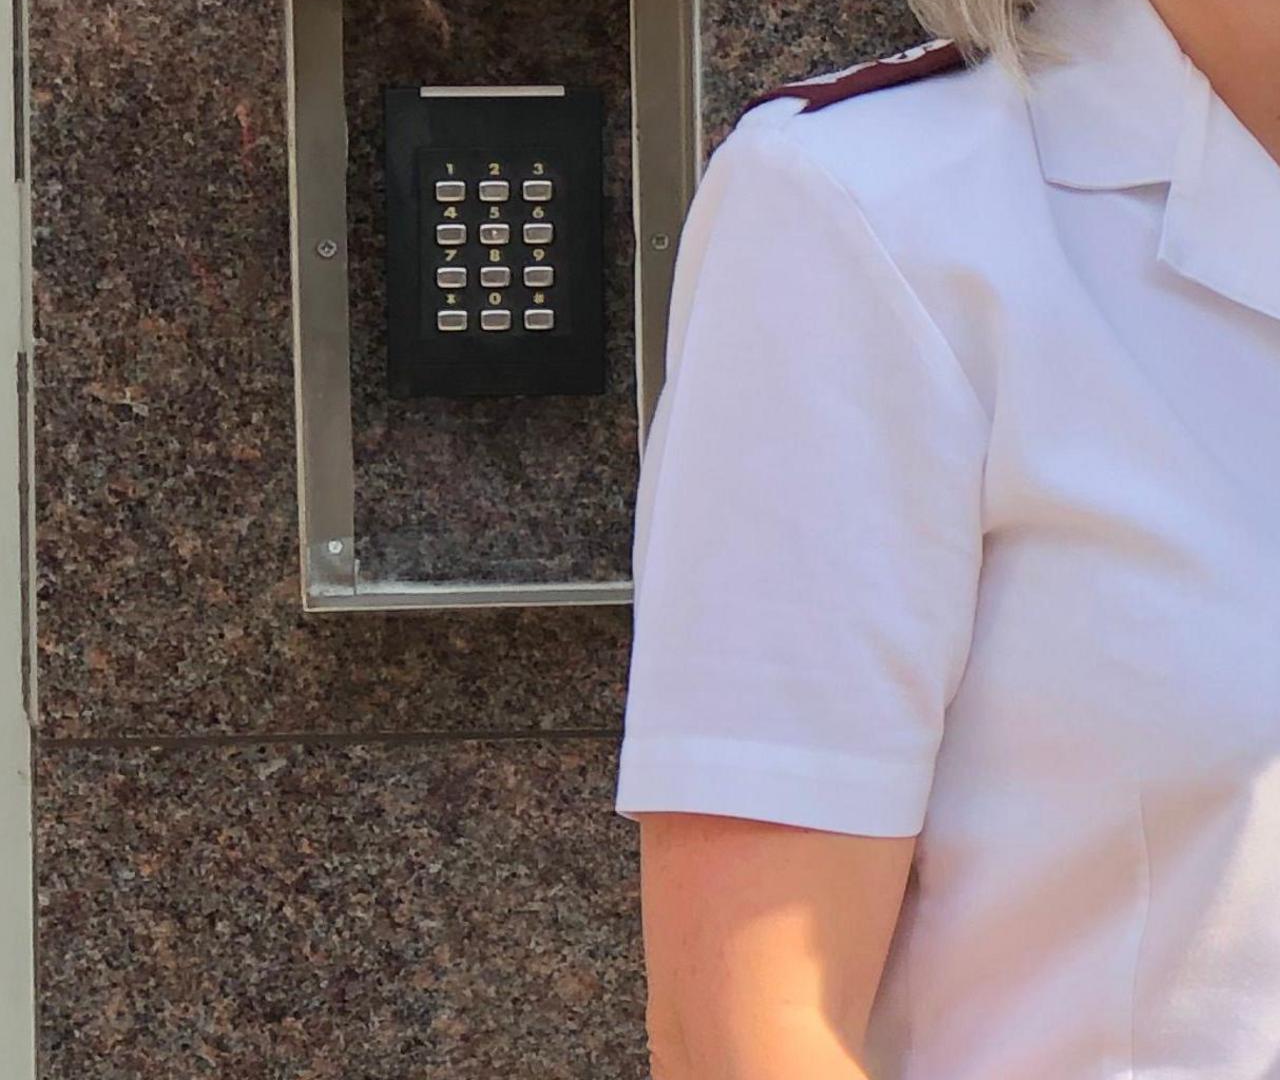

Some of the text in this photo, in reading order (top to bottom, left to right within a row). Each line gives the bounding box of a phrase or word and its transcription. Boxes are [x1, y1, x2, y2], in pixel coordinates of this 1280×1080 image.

[446, 163, 544, 175] 1 2 3
[444, 206, 544, 218] 4 5 6
[445, 249, 545, 261] 7 8 9
[489, 292, 501, 305] 0
